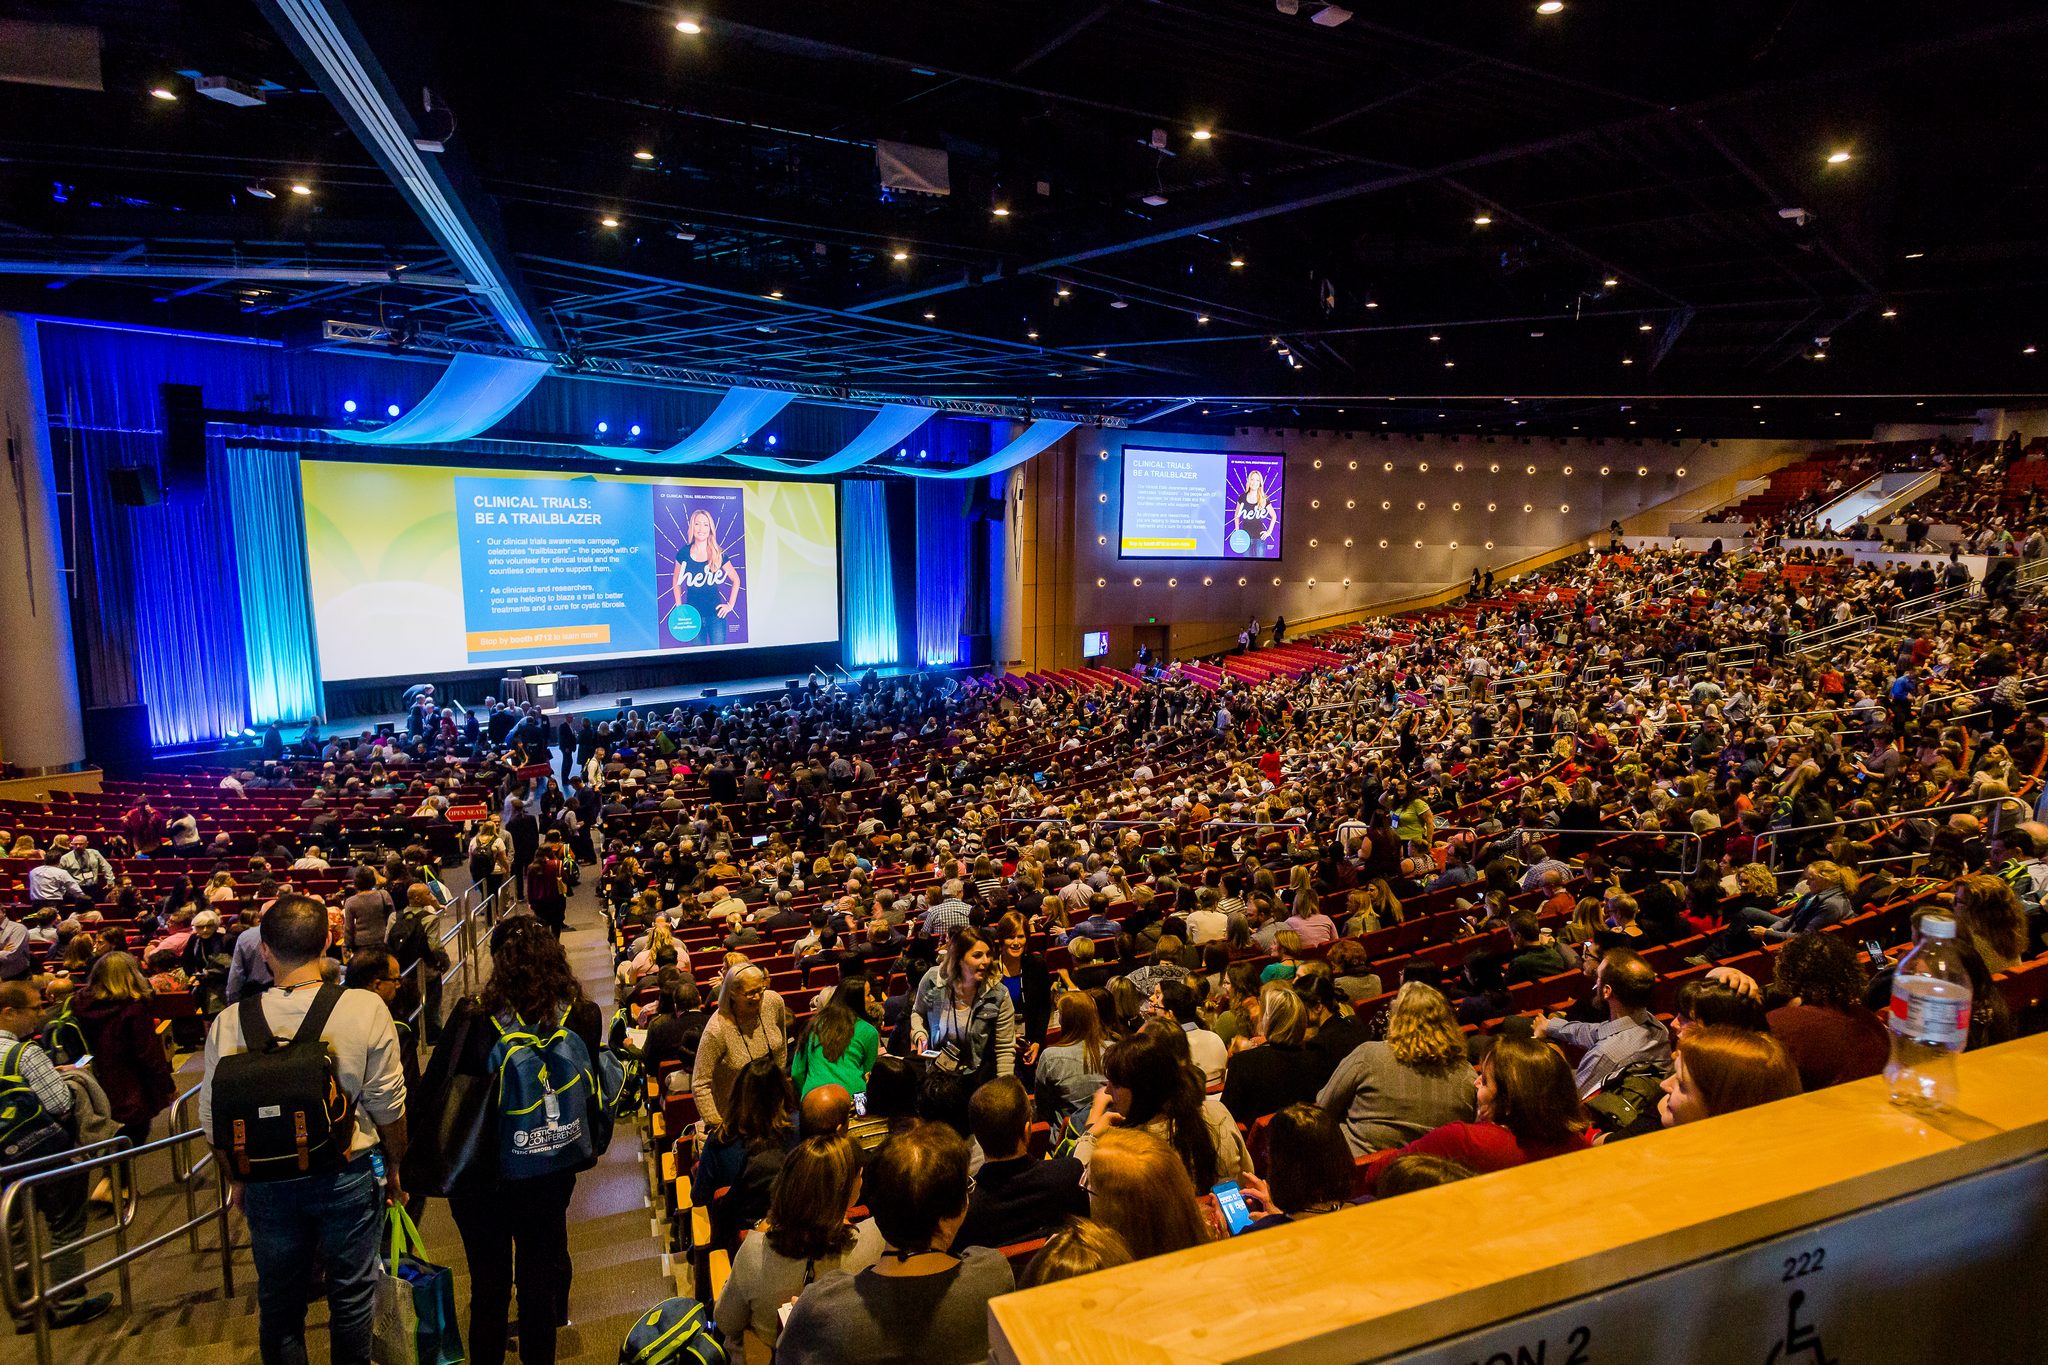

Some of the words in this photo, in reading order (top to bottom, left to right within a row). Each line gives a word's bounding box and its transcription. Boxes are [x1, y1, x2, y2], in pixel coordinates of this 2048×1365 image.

[1132, 460, 1165, 468] CLINICAL
[1167, 461, 1192, 470] TRIALS:
[1151, 471, 1198, 479] TRAILBLAZER
[474, 496, 538, 508] CLINICAL
[541, 497, 591, 509] TRIALS:
[1238, 502, 1269, 519] here
[475, 512, 494, 524] BE
[498, 513, 508, 524] A
[511, 513, 601, 525] TRAILBLAZER
[487, 538, 501, 546] Our
[503, 537, 528, 545] clinical
[530, 537, 547, 545] trials
[587, 537, 619, 547] campaign
[487, 547, 526, 555] celebrates
[591, 547, 613, 556] people
[488, 557, 504, 565] who
[541, 556, 550, 564] for
[489, 567, 524, 575] countless
[677, 560, 727, 587] here
[491, 597, 505, 605] you
[520, 596, 546, 604] helping
[491, 606, 530, 614] treatments
[581, 602, 600, 611] cystic
[601, 601, 626, 609] fibrosis.
[480, 638, 497, 646] Stop
[500, 637, 509, 645] by
[510, 635, 533, 644] booth
[534, 634, 552, 642] #712
[562, 632, 579, 640] learn
[529, 1125, 580, 1145] CONFERENCE
[530, 1129, 551, 1138] CYSTIC
[529, 1146, 551, 1154] FIBROSIS
[553, 1133, 581, 1149] FOUNDATION
[1783, 1247, 1825, 1281] 222
[1567, 1326, 1591, 1365] 2
